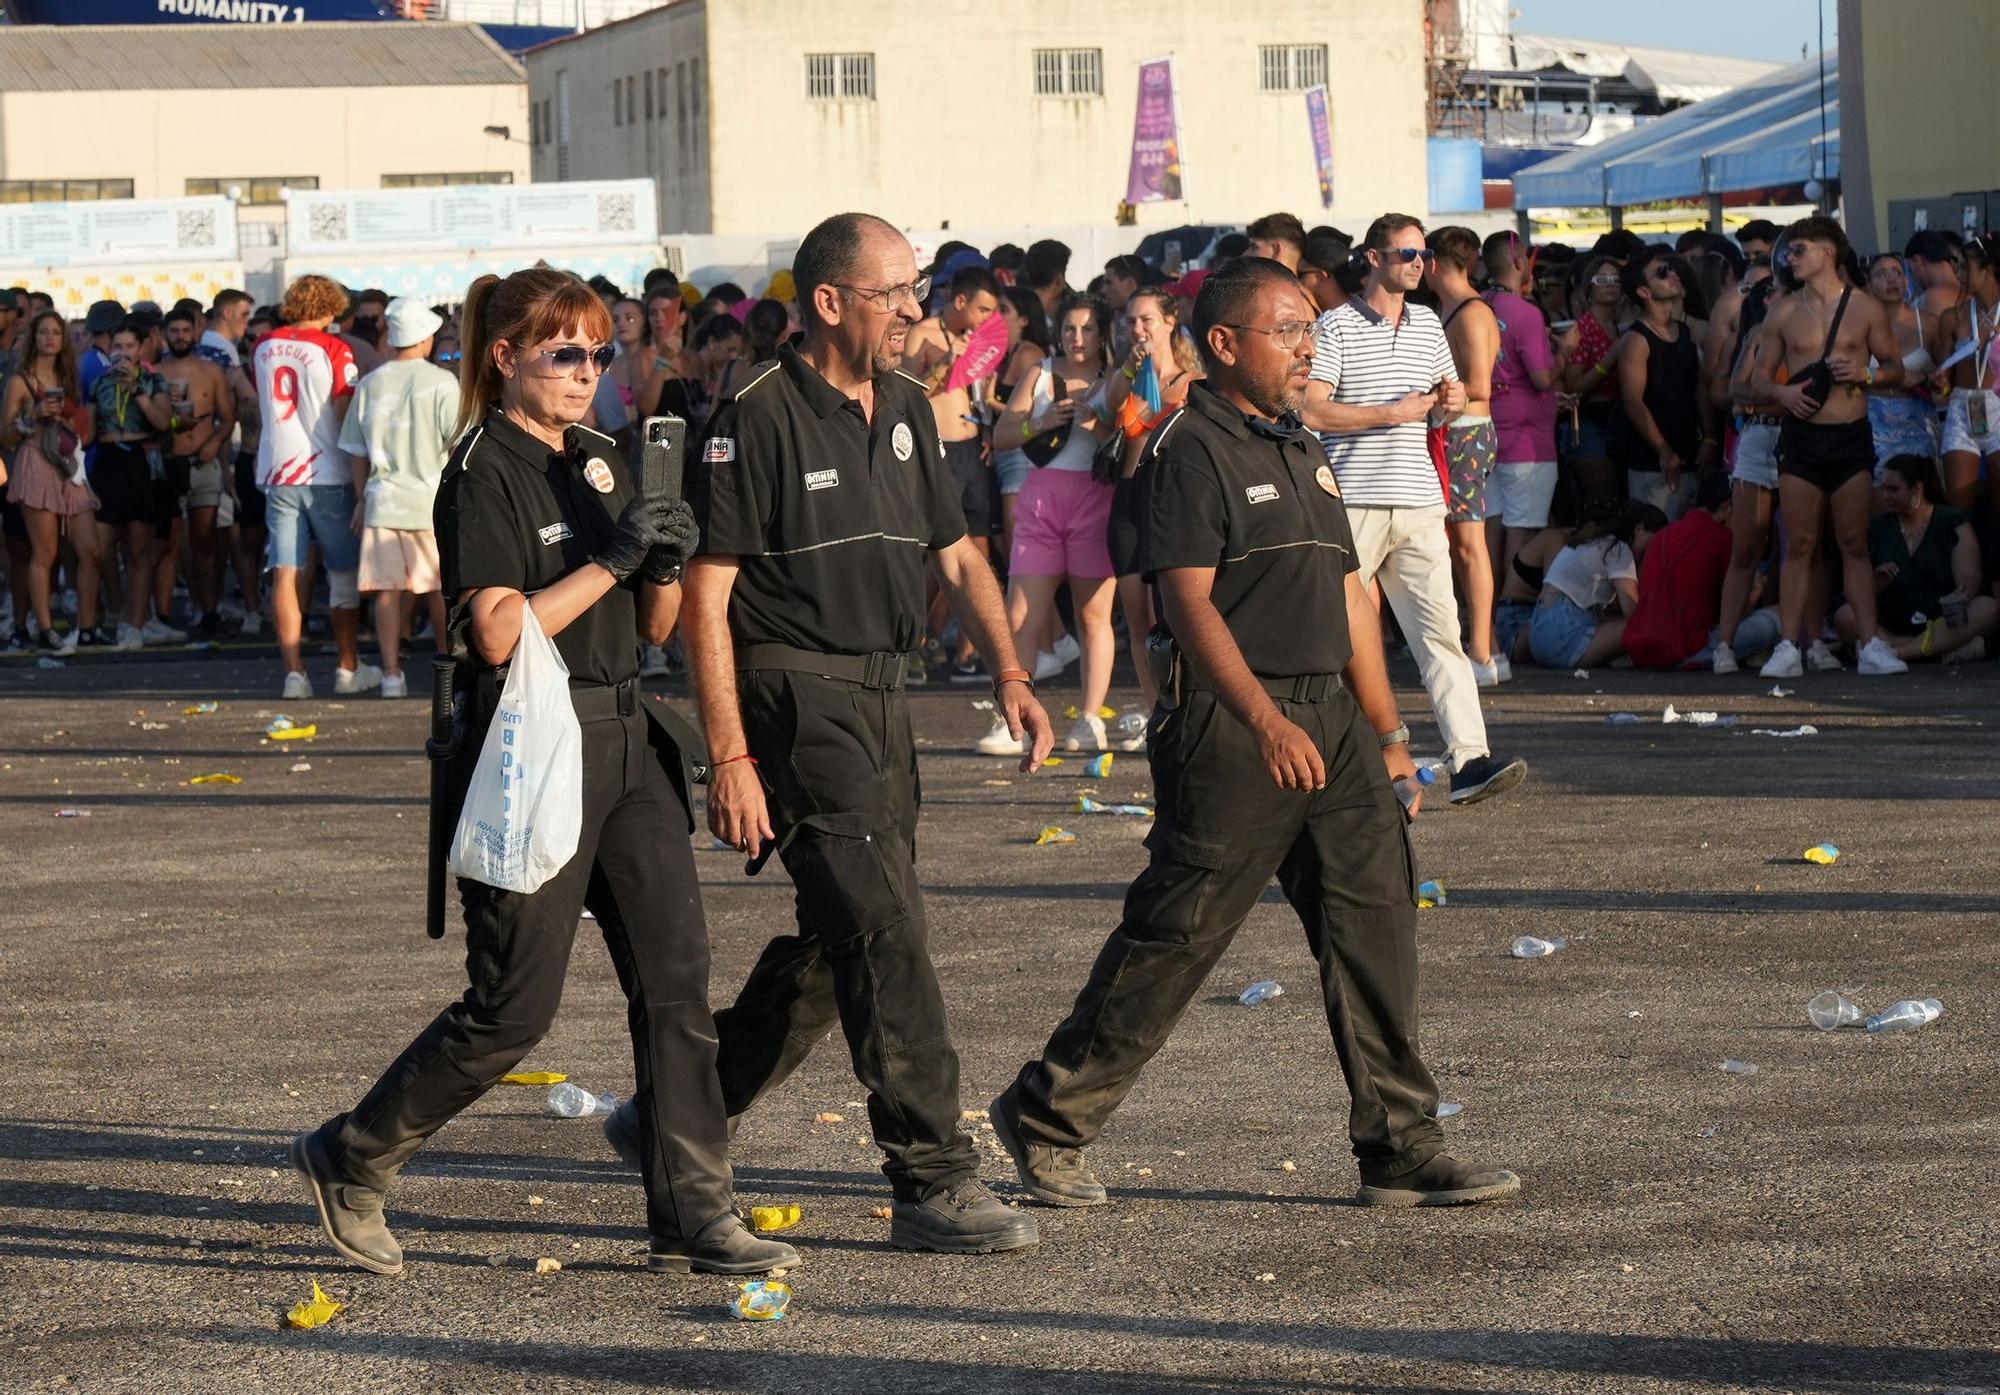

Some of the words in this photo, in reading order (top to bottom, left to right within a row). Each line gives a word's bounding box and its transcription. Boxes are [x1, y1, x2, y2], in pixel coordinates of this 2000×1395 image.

[158, 0, 289, 24] HUMANITY
[292, 7, 305, 24] 1
[260, 344, 313, 366] PASCUAL
[274, 366, 299, 423] 9
[807, 471, 836, 484] OMNIA
